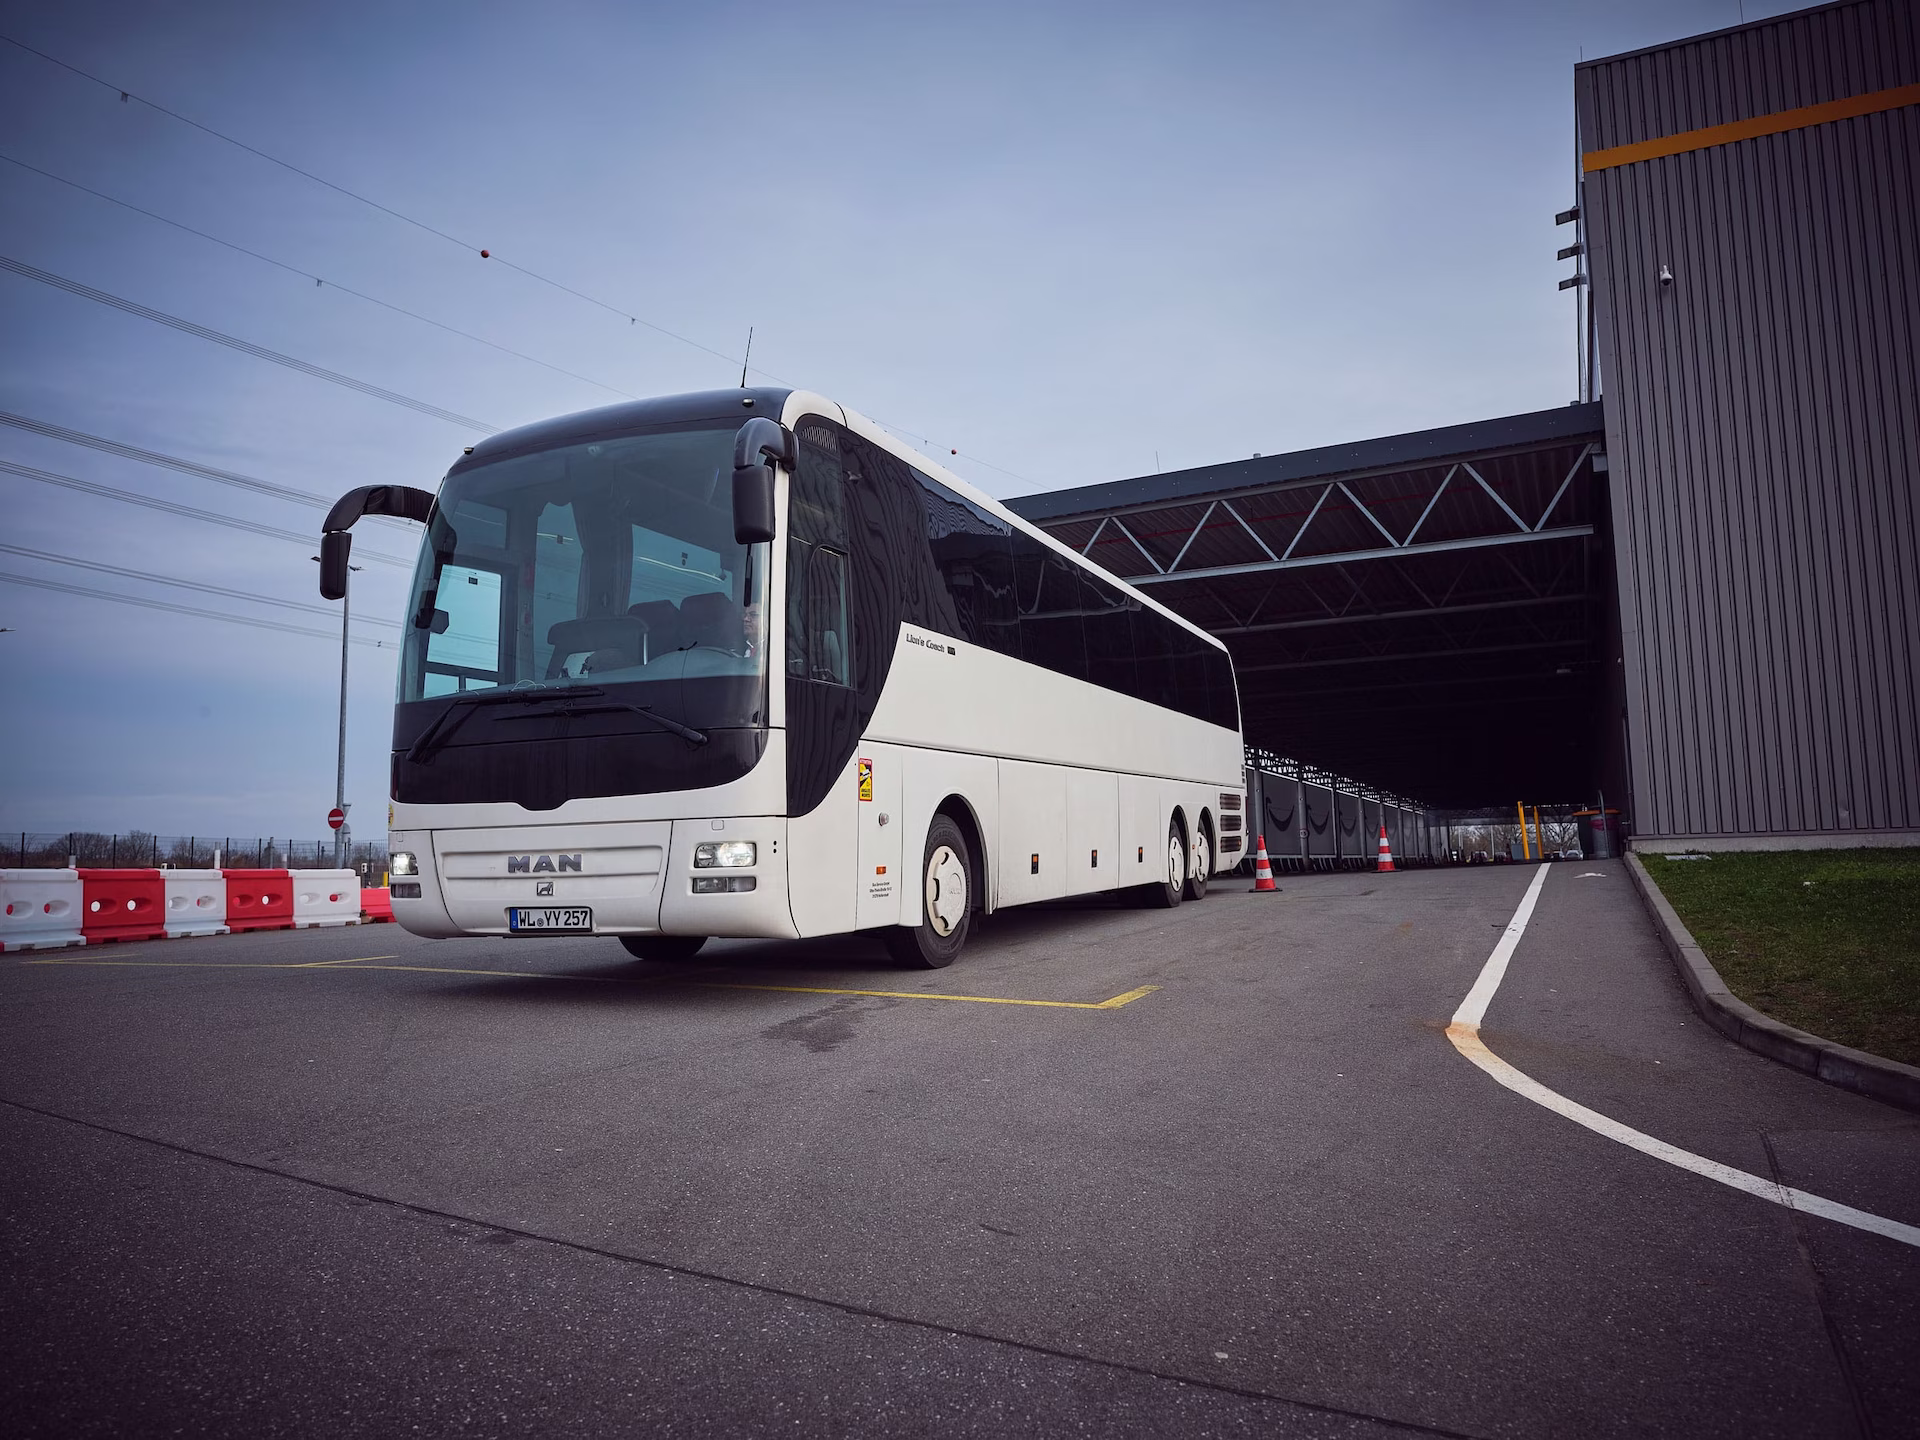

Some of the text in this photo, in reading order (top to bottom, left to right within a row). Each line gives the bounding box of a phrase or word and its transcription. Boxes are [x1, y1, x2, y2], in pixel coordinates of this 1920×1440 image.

[926, 640, 945, 653] Coach
[508, 854, 583, 873] MAN
[519, 910, 588, 926] WL YY 257
